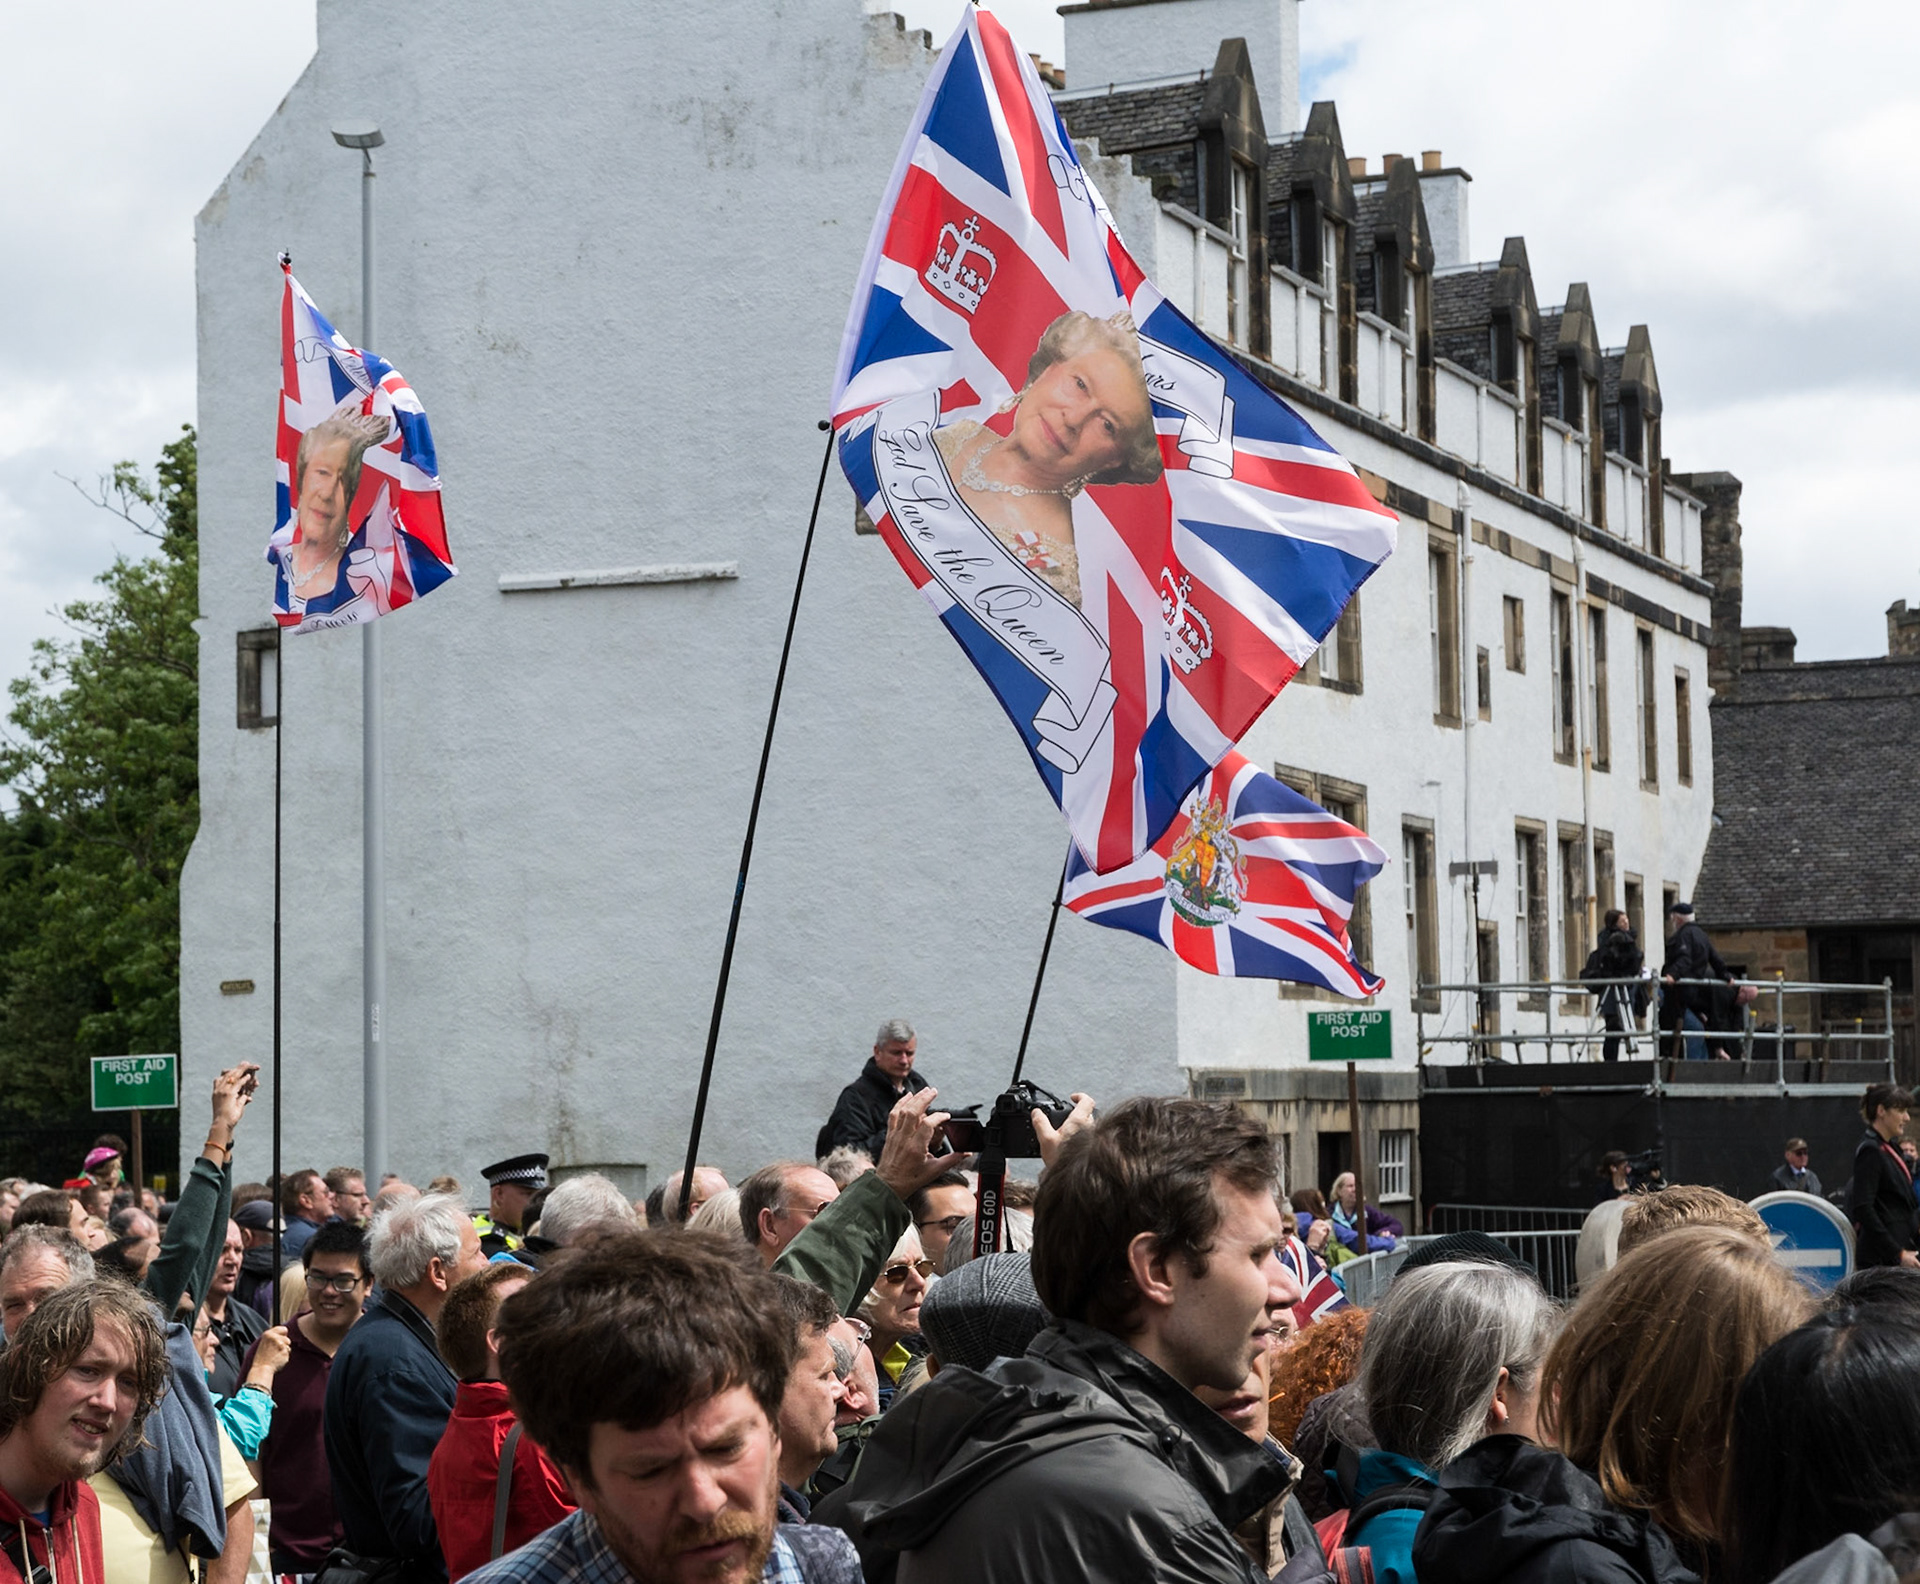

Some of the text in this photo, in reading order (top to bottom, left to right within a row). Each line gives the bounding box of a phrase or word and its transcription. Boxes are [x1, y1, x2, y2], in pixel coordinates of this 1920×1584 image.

[879, 420, 1065, 664] God Save the Queen
[1316, 1012, 1382, 1025] FIRST AID
[1331, 1024, 1368, 1037] POST
[101, 1058, 166, 1073] FIRST AID
[115, 1071, 152, 1085] POST
[980, 1190, 996, 1254] EOS 60D
